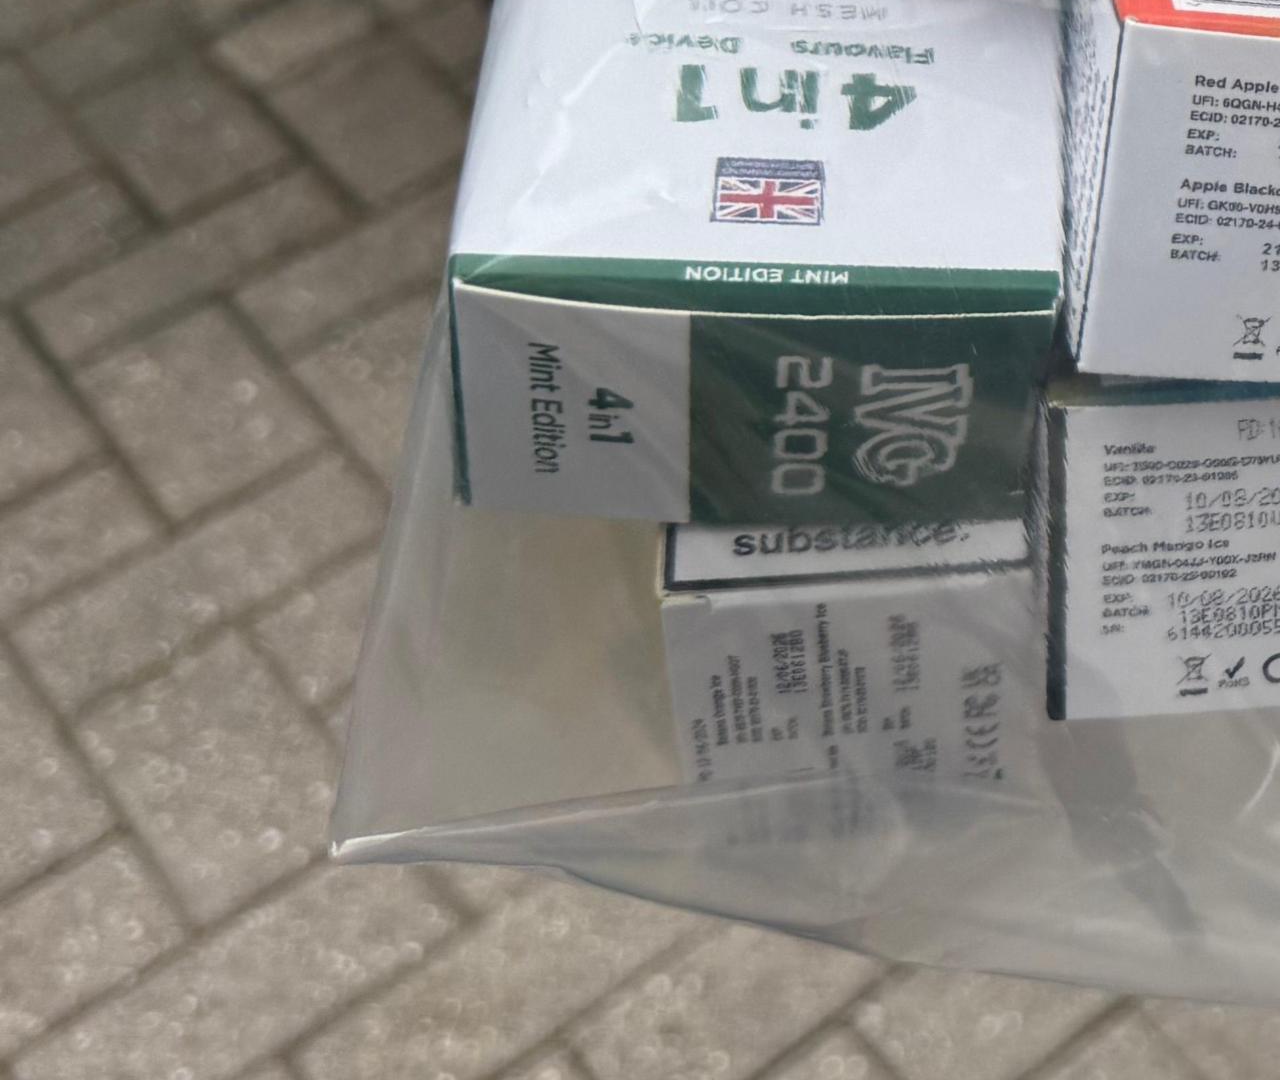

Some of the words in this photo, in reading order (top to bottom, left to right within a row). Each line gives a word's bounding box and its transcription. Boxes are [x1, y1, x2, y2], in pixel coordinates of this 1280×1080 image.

[791, 4, 888, 21] MESH
[625, 31, 744, 54] Device
[791, 39, 935, 65] Flavours
[672, 64, 719, 121] 1
[1194, 75, 1227, 90] Red
[1231, 77, 1279, 95] Apple
[740, 67, 820, 129] in
[840, 73, 917, 130] 4
[1192, 94, 1219, 108] UFI:
[1190, 110, 1228, 124] ECID:
[1187, 128, 1220, 141] EXP:
[1185, 144, 1237, 159] BATCH:
[1180, 178, 1227, 193] Apple
[1177, 198, 1204, 210] UFI:
[1171, 233, 1203, 245] EXP:
[685, 265, 783, 283] EDITION
[791, 268, 849, 285] MINT
[527, 340, 563, 391] Mint
[532, 394, 571, 474] Edition
[770, 356, 835, 498] 2400
[854, 362, 973, 488] IVG
[1101, 540, 1148, 555] Peach
[1153, 540, 1204, 554] Mango
[1207, 539, 1230, 550] Ice
